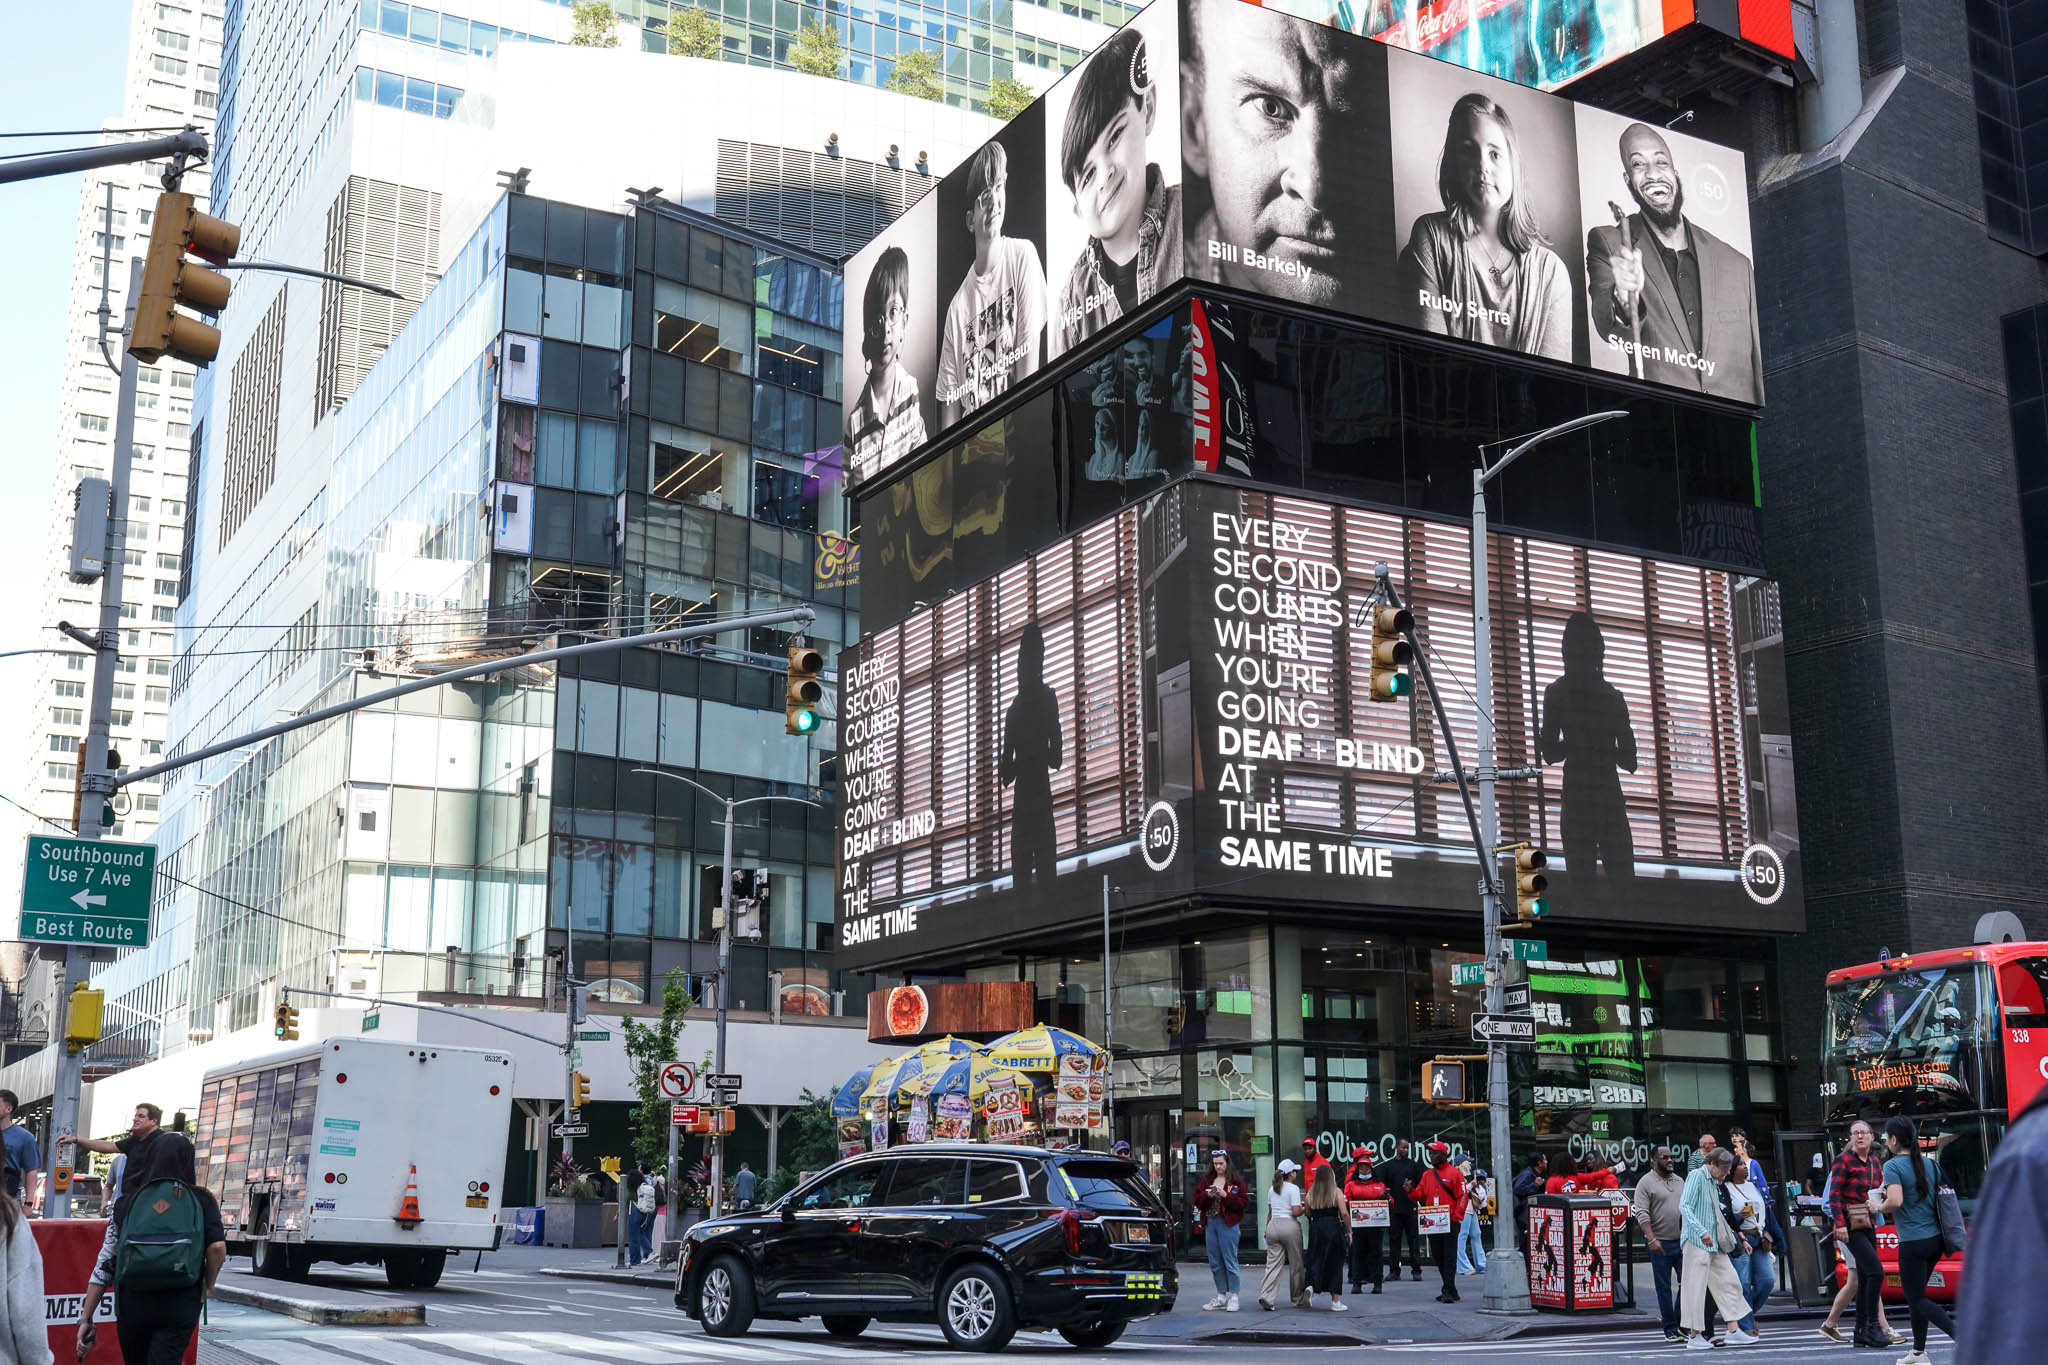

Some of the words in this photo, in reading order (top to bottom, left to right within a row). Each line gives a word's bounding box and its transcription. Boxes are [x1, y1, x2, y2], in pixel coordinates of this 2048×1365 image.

[1208, 240, 1238, 263] Bill
[1243, 248, 1312, 283] Barkely
[1419, 289, 1463, 318] Ruby
[1467, 301, 1511, 326] Serra
[1664, 346, 1716, 377] McCoy
[947, 373, 979, 407] Hunte
[1213, 512, 1310, 551] EVERY
[1214, 548, 1342, 593] SECOND
[1214, 584, 1343, 627] COUNTS
[1214, 618, 1309, 658] WHEN
[846, 653, 888, 693] EVERY
[1215, 653, 1329, 695] YOU'RE
[845, 675, 900, 720] SECOND
[1217, 690, 1319, 728] GOING
[845, 705, 900, 747] COUNTS
[844, 737, 884, 777] WHEN
[1218, 726, 1303, 762] DEAF
[1310, 741, 1327, 761] +
[1336, 738, 1425, 775] BLIND
[844, 765, 892, 803] YOU'RE
[1218, 763, 1258, 793] AT
[844, 797, 887, 831] GOING
[1219, 799, 1281, 834] THE
[843, 827, 880, 861] DEAF
[892, 809, 936, 846] BLIND
[40, 842, 145, 867] Southbound
[1220, 837, 1311, 872] SAME
[1318, 843, 1393, 878] TIME
[48, 865, 78, 883] Use
[84, 867, 95, 883] 7
[101, 869, 131, 887] Ave
[843, 862, 861, 890] AT
[1751, 866, 1776, 885] :50
[843, 888, 869, 918] THE
[36, 918, 75, 937] Best
[82, 921, 133, 940] Route
[842, 914, 881, 946] SAME
[882, 905, 918, 938] TIME
[1521, 942, 1527, 957] 7
[1462, 967, 1468, 982] W
[1469, 966, 1478, 981] 47
[1508, 991, 1523, 1004] WAY
[582, 1033, 608, 1041] Broadway
[1481, 1022, 1500, 1033] ONE
[1510, 1023, 1530, 1034] WAY
[2012, 1029, 2030, 1043] 338
[991, 1057, 1051, 1068] SABRETT
[1820, 1082, 1837, 1096] 338
[1573, 1210, 1589, 1221] BEAT
[1573, 1221, 1589, 1237] IT
[1549, 1231, 1563, 1246] BAD
[1594, 1231, 1610, 1247] BAD
